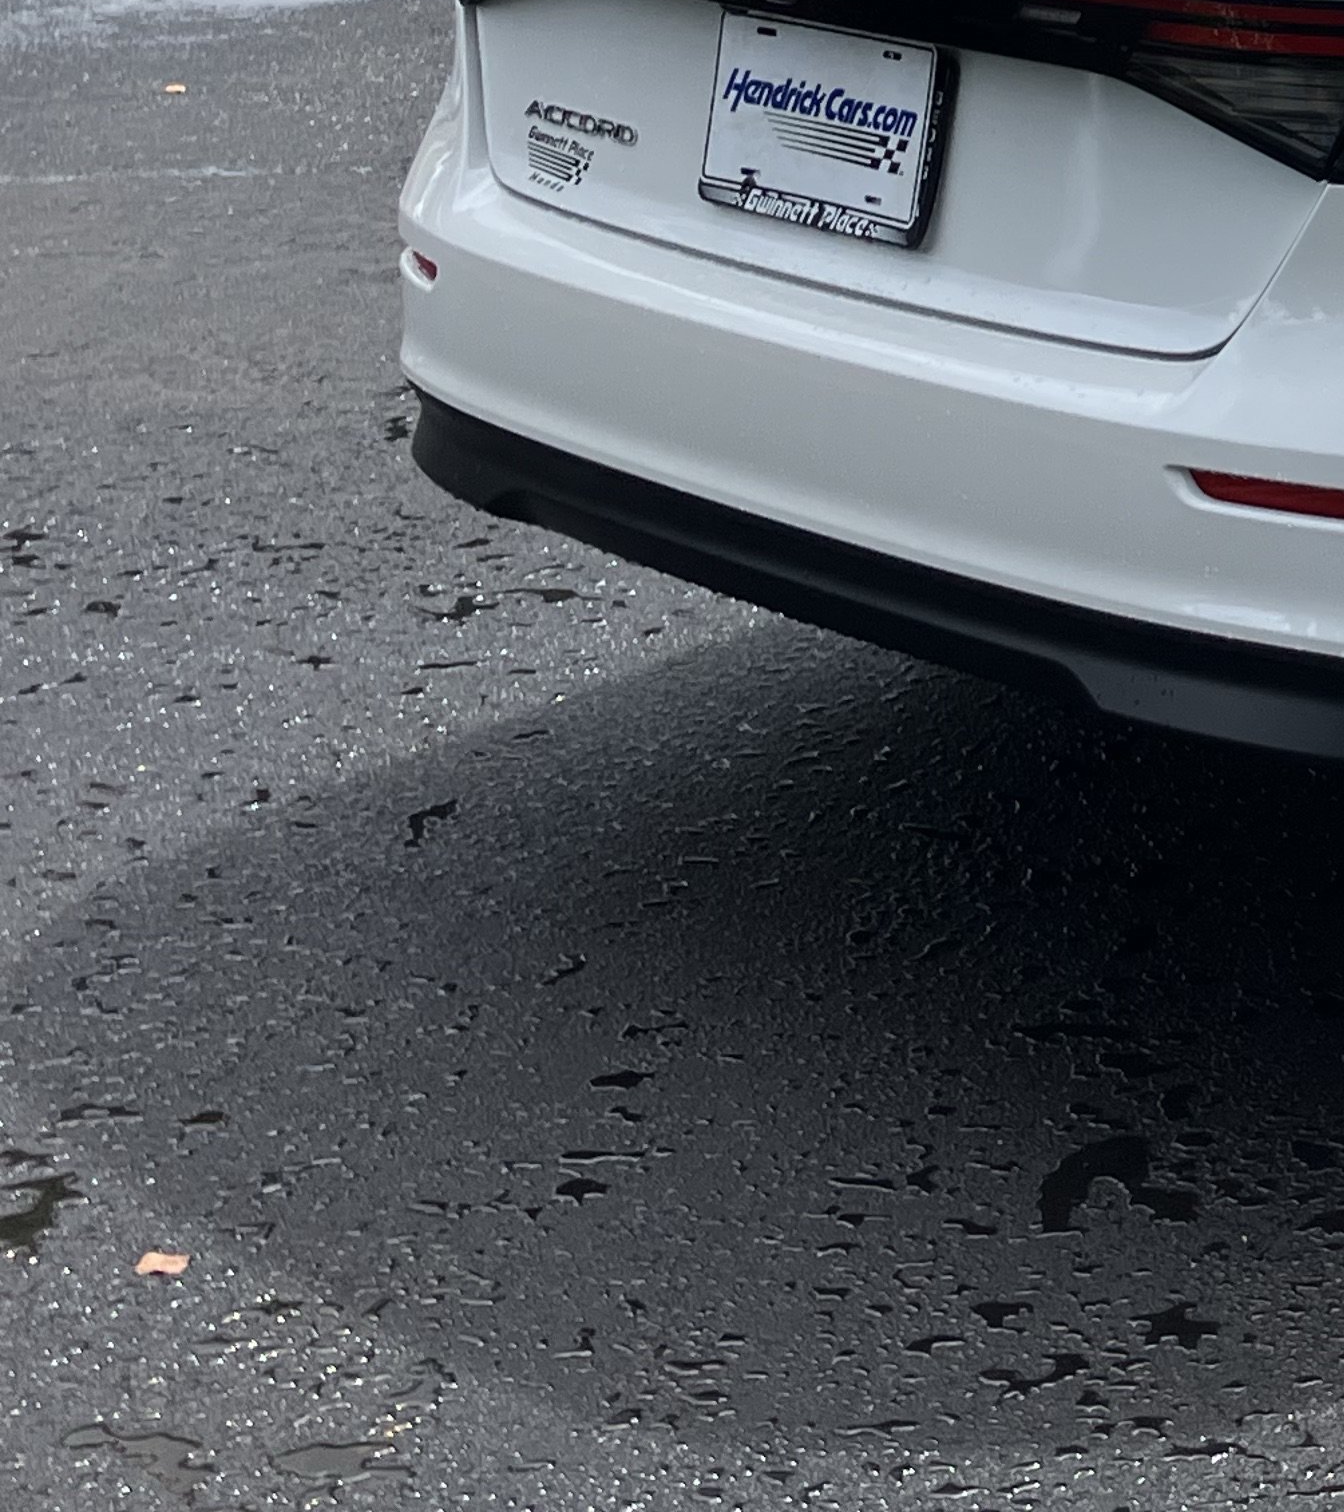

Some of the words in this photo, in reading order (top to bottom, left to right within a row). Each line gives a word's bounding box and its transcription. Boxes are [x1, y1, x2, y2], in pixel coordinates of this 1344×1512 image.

[524, 99, 638, 147] ACCORD
[743, 188, 820, 225] Gwinnett
[818, 203, 871, 236] Place
